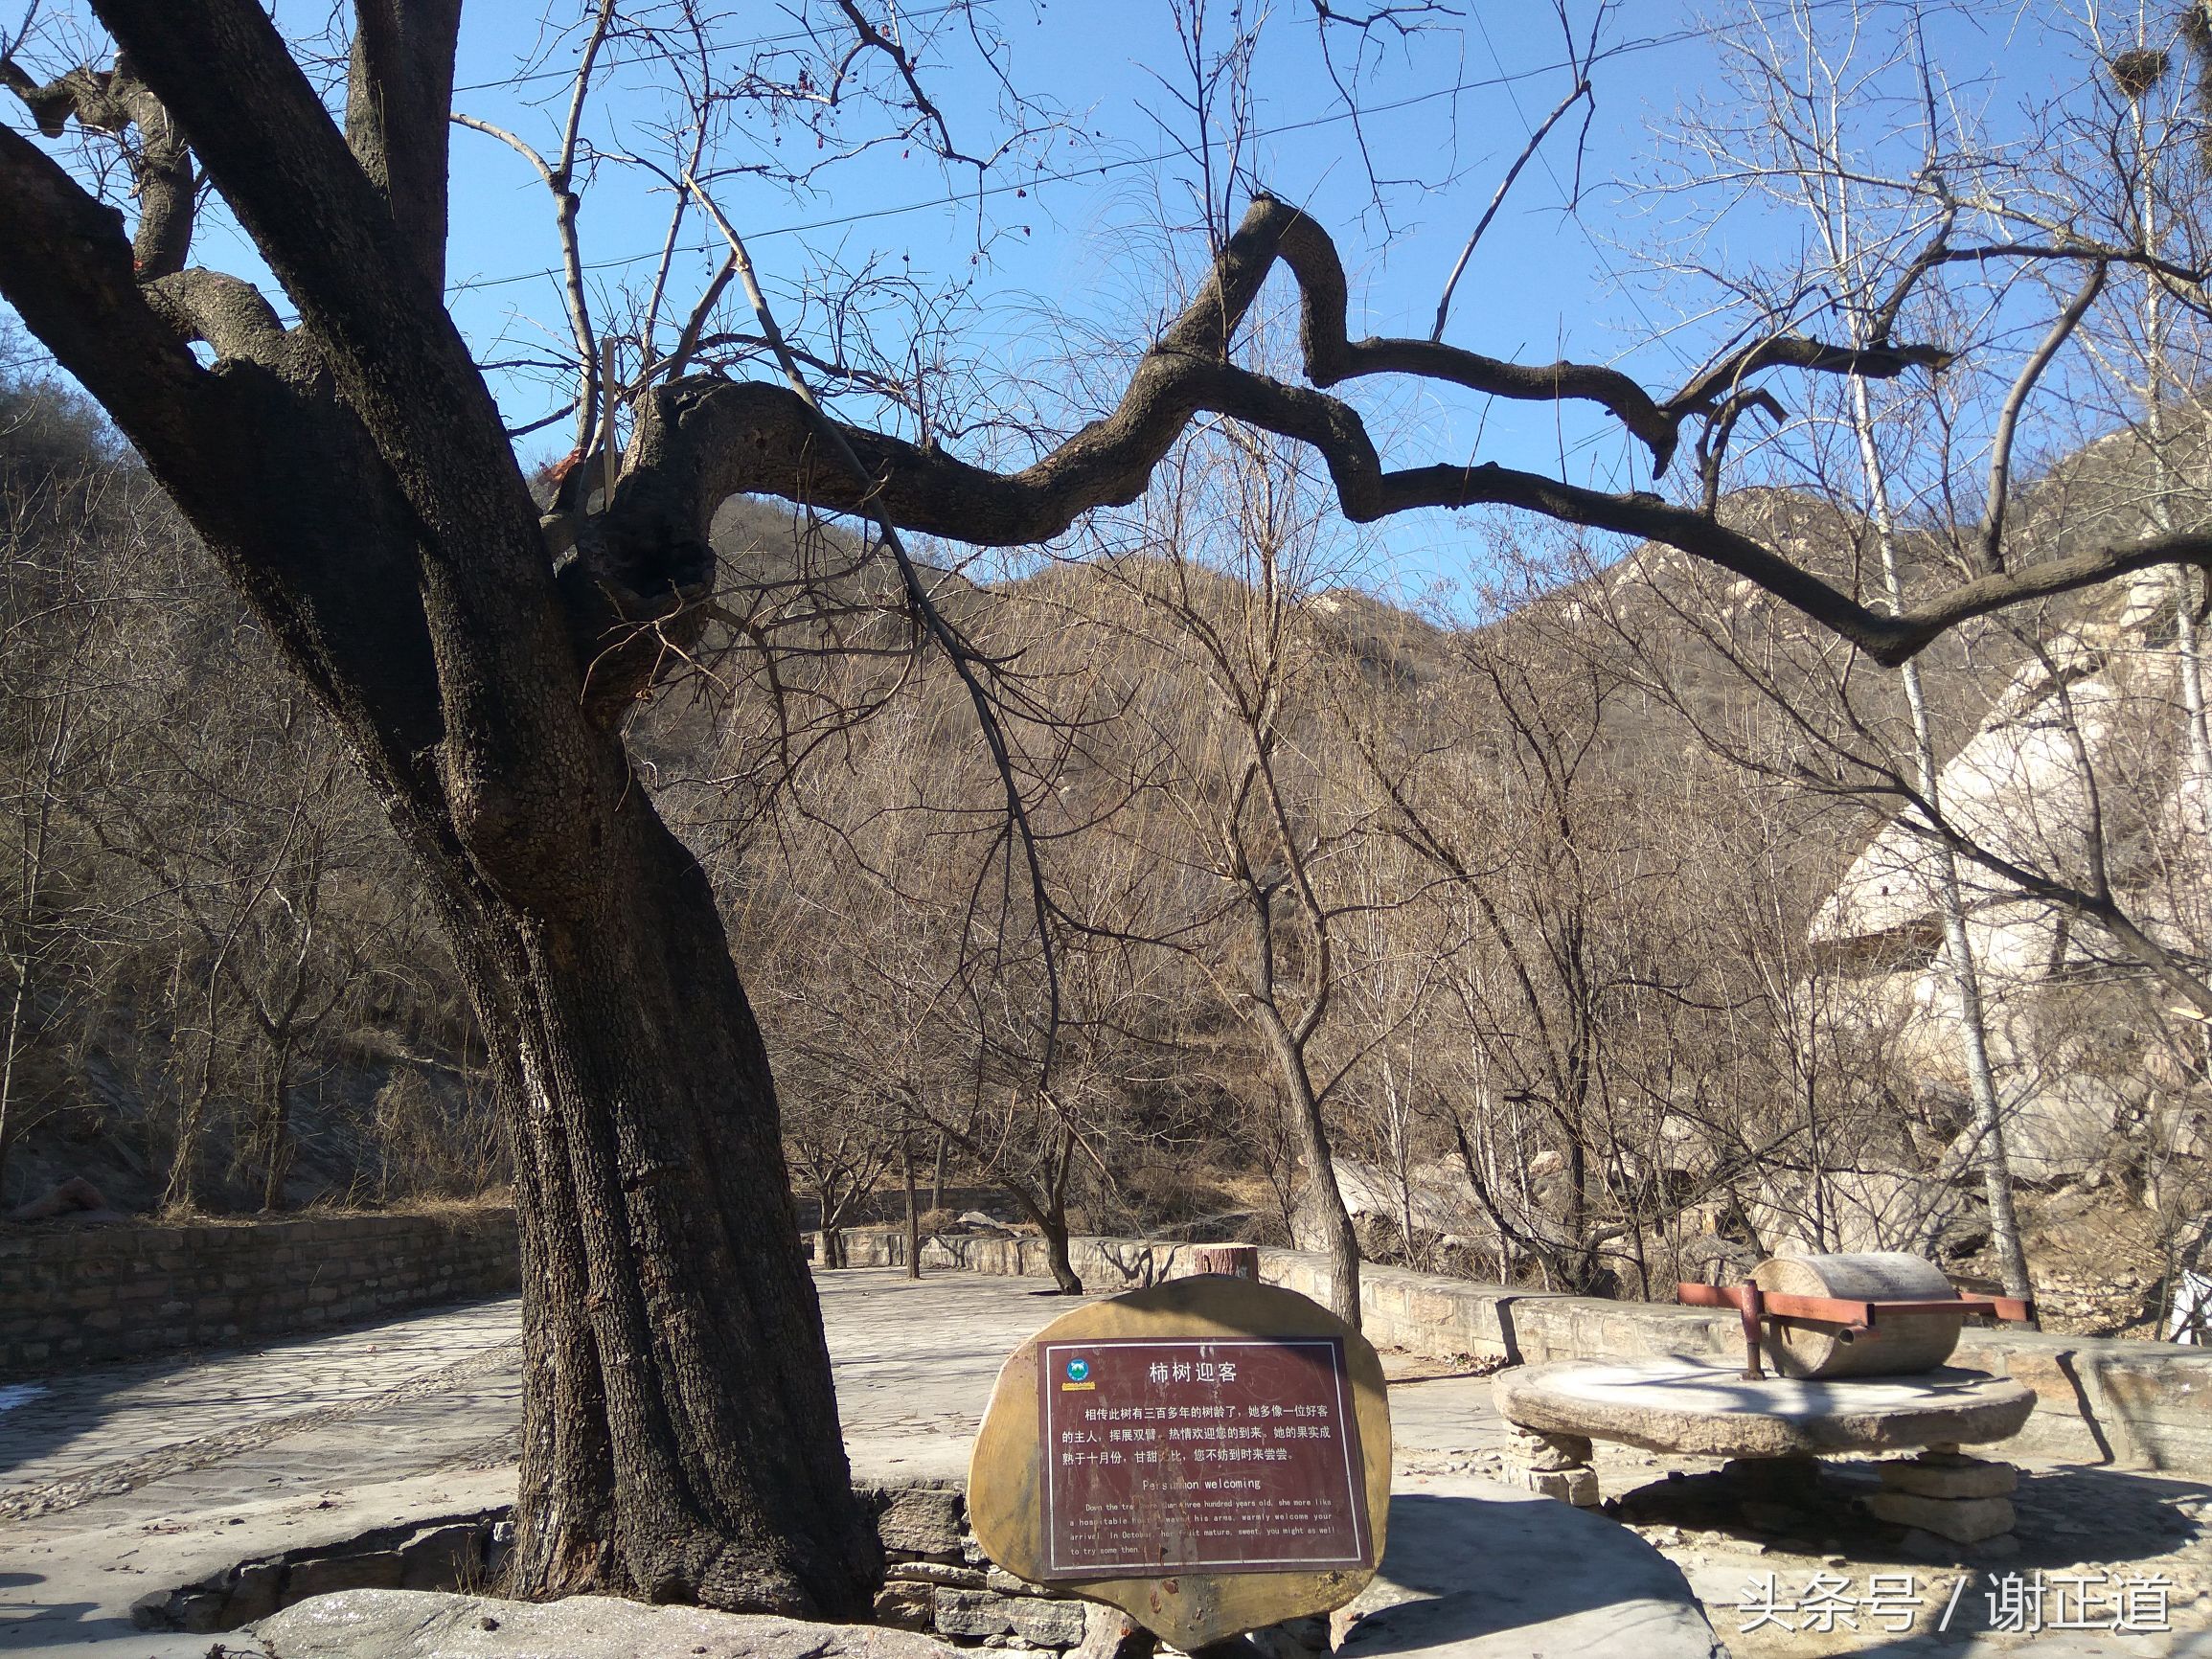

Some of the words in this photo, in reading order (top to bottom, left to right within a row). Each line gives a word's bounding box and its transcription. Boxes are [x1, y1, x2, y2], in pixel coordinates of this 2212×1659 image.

[1150, 1361, 1237, 1383] 柿树迎客
[1061, 1447, 1293, 1466] 熟于十月份，甘甜比，您不妨到时来尝尝。
[1205, 1478, 1261, 1490] welcoming
[1106, 1503, 1118, 1511] the
[1122, 1502, 1137, 1511] tre
[1236, 1500, 1256, 1509] years
[1315, 1498, 1332, 1507] like
[1079, 1516, 1128, 1527] hospitable
[1195, 1513, 1210, 1522] his
[1242, 1512, 1270, 1522] warmly
[1275, 1512, 1309, 1521] welcome
[1178, 1529, 1199, 1537] fuit
[1266, 1528, 1280, 1536] you
[1283, 1527, 1304, 1535] might
[1083, 1547, 1096, 1557] try
